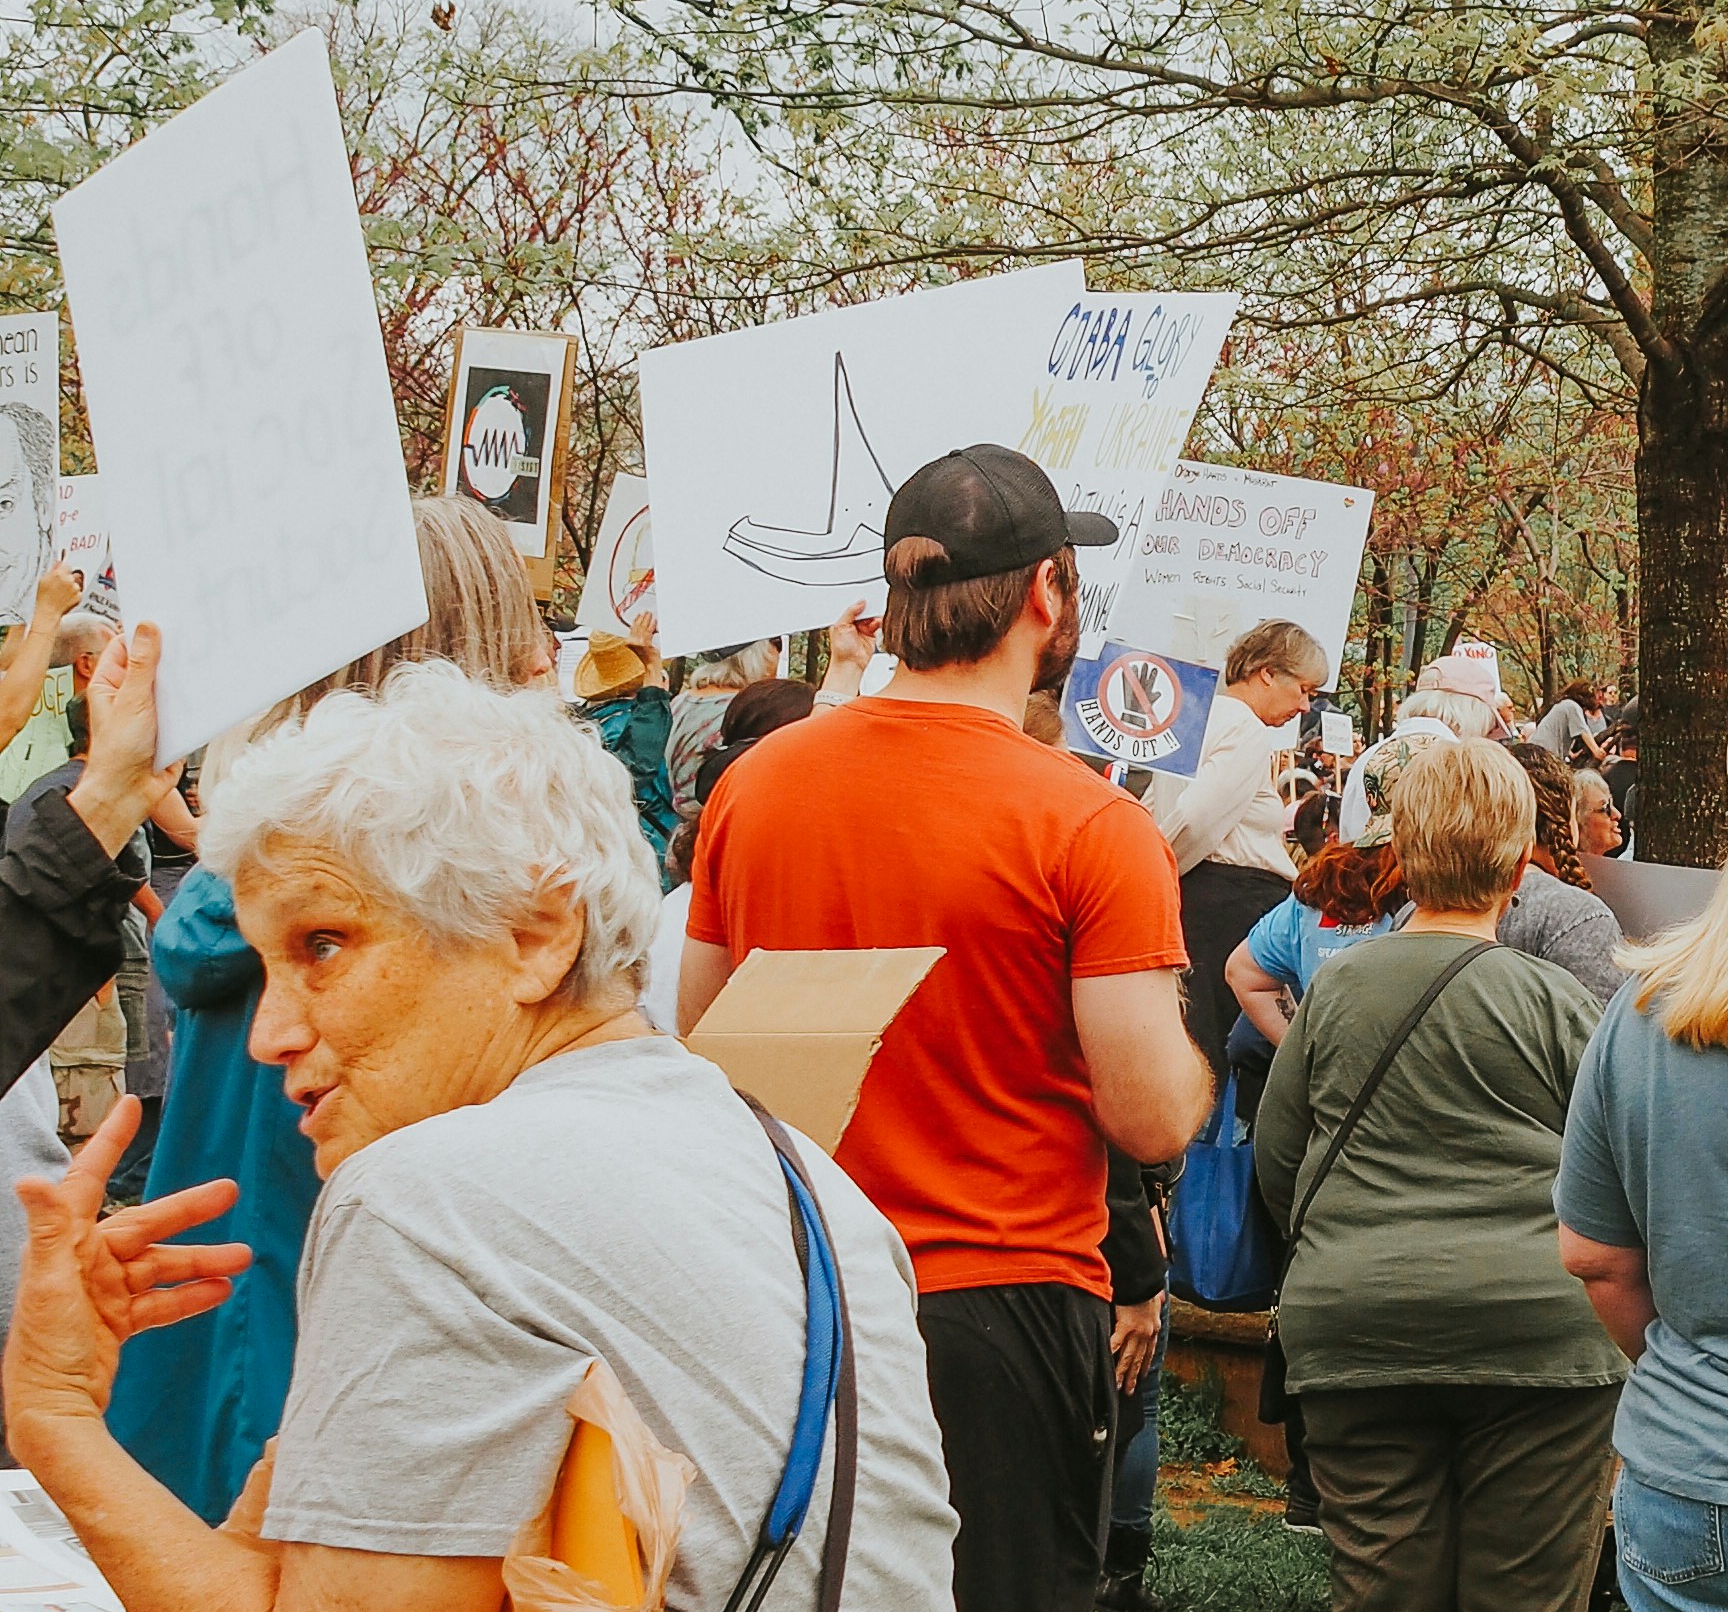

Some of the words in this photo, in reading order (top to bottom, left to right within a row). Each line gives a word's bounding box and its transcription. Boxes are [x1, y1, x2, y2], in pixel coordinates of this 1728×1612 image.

[1132, 304, 1204, 380] GLORY
[1095, 403, 1190, 471] UKRAINE
[1156, 489, 1247, 528] HANDS
[1259, 506, 1317, 539] OFF
[70, 532, 102, 551] BAD!
[1141, 534, 1181, 555] OUR
[1198, 538, 1329, 578] DEMOCRACY
[1081, 700, 1125, 751] HANDS
[1132, 738, 1159, 758] OFF
